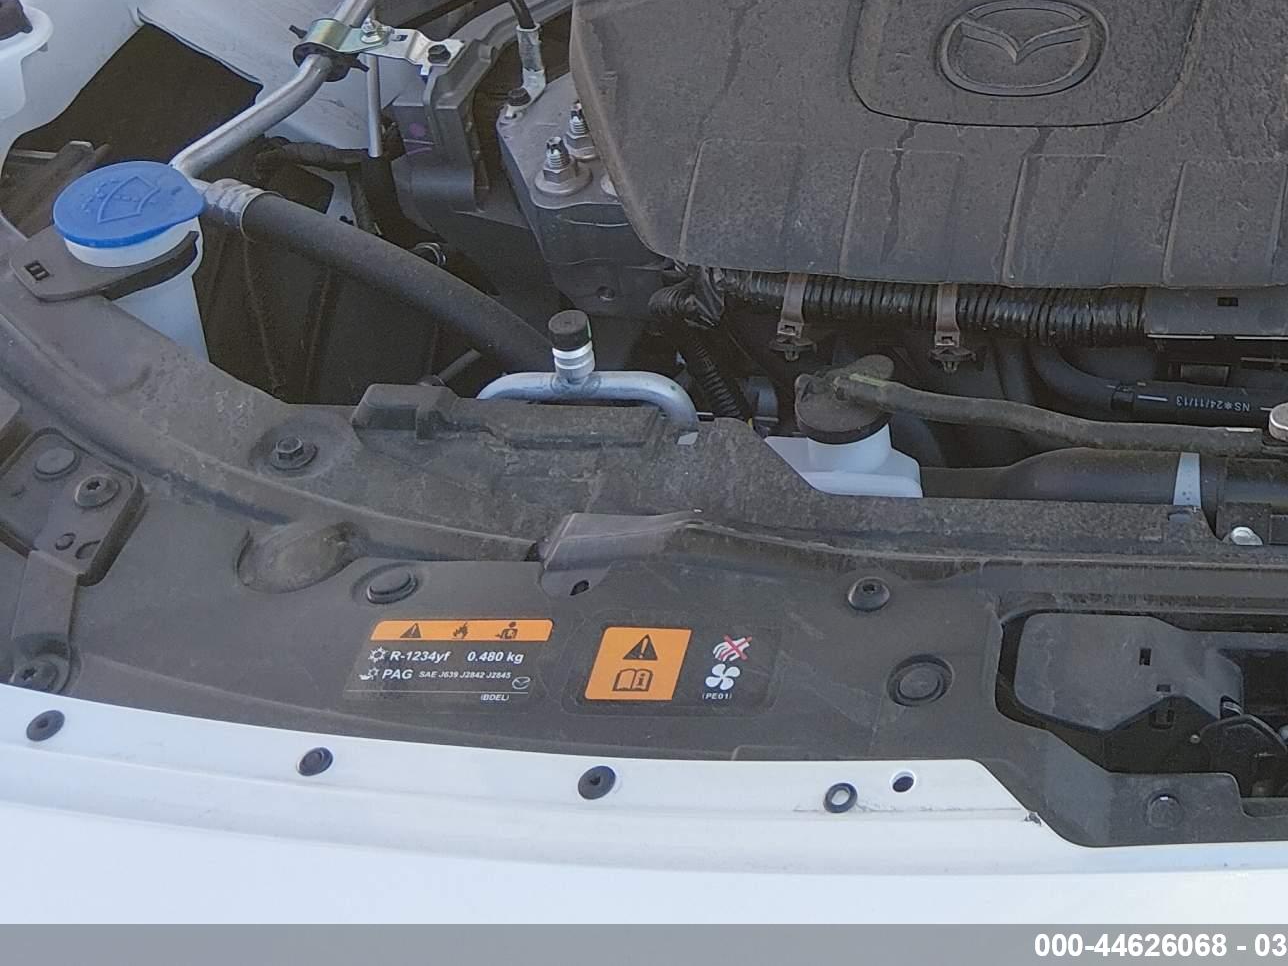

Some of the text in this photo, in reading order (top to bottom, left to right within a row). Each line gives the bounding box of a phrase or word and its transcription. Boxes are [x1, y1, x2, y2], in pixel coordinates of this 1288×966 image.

[389, 650, 525, 665] R-1234yf 0.480 kg
[381, 668, 414, 680] PAG
[418, 670, 438, 679] SAE
[438, 670, 460, 679] J639
[460, 671, 485, 679] J2842
